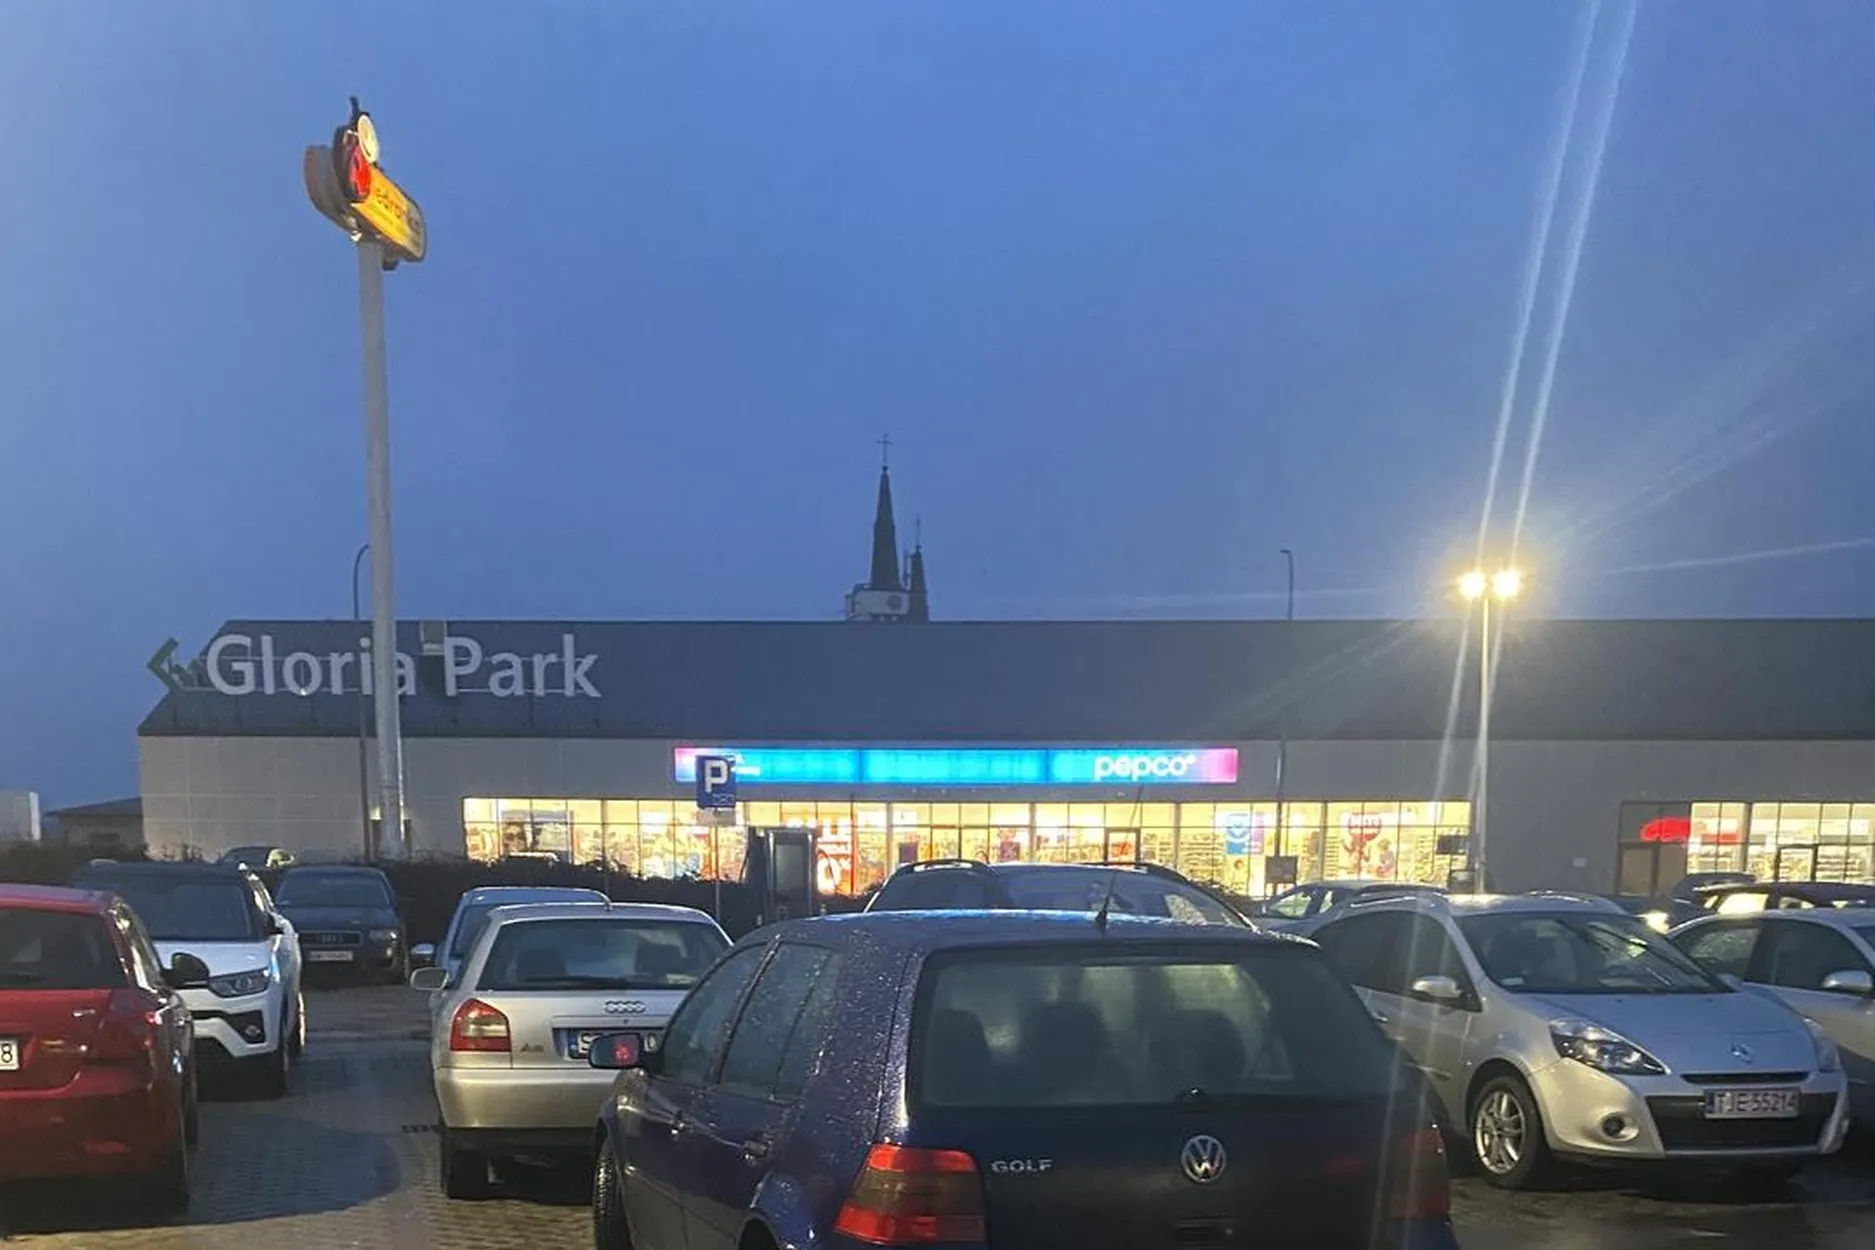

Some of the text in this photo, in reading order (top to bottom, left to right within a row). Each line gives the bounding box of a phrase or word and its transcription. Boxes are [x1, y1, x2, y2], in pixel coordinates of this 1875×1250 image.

[444, 634, 602, 697] Park
[704, 760, 729, 793] P
[1094, 755, 1190, 782] pepco
[991, 1159, 1053, 1174] GOLF
